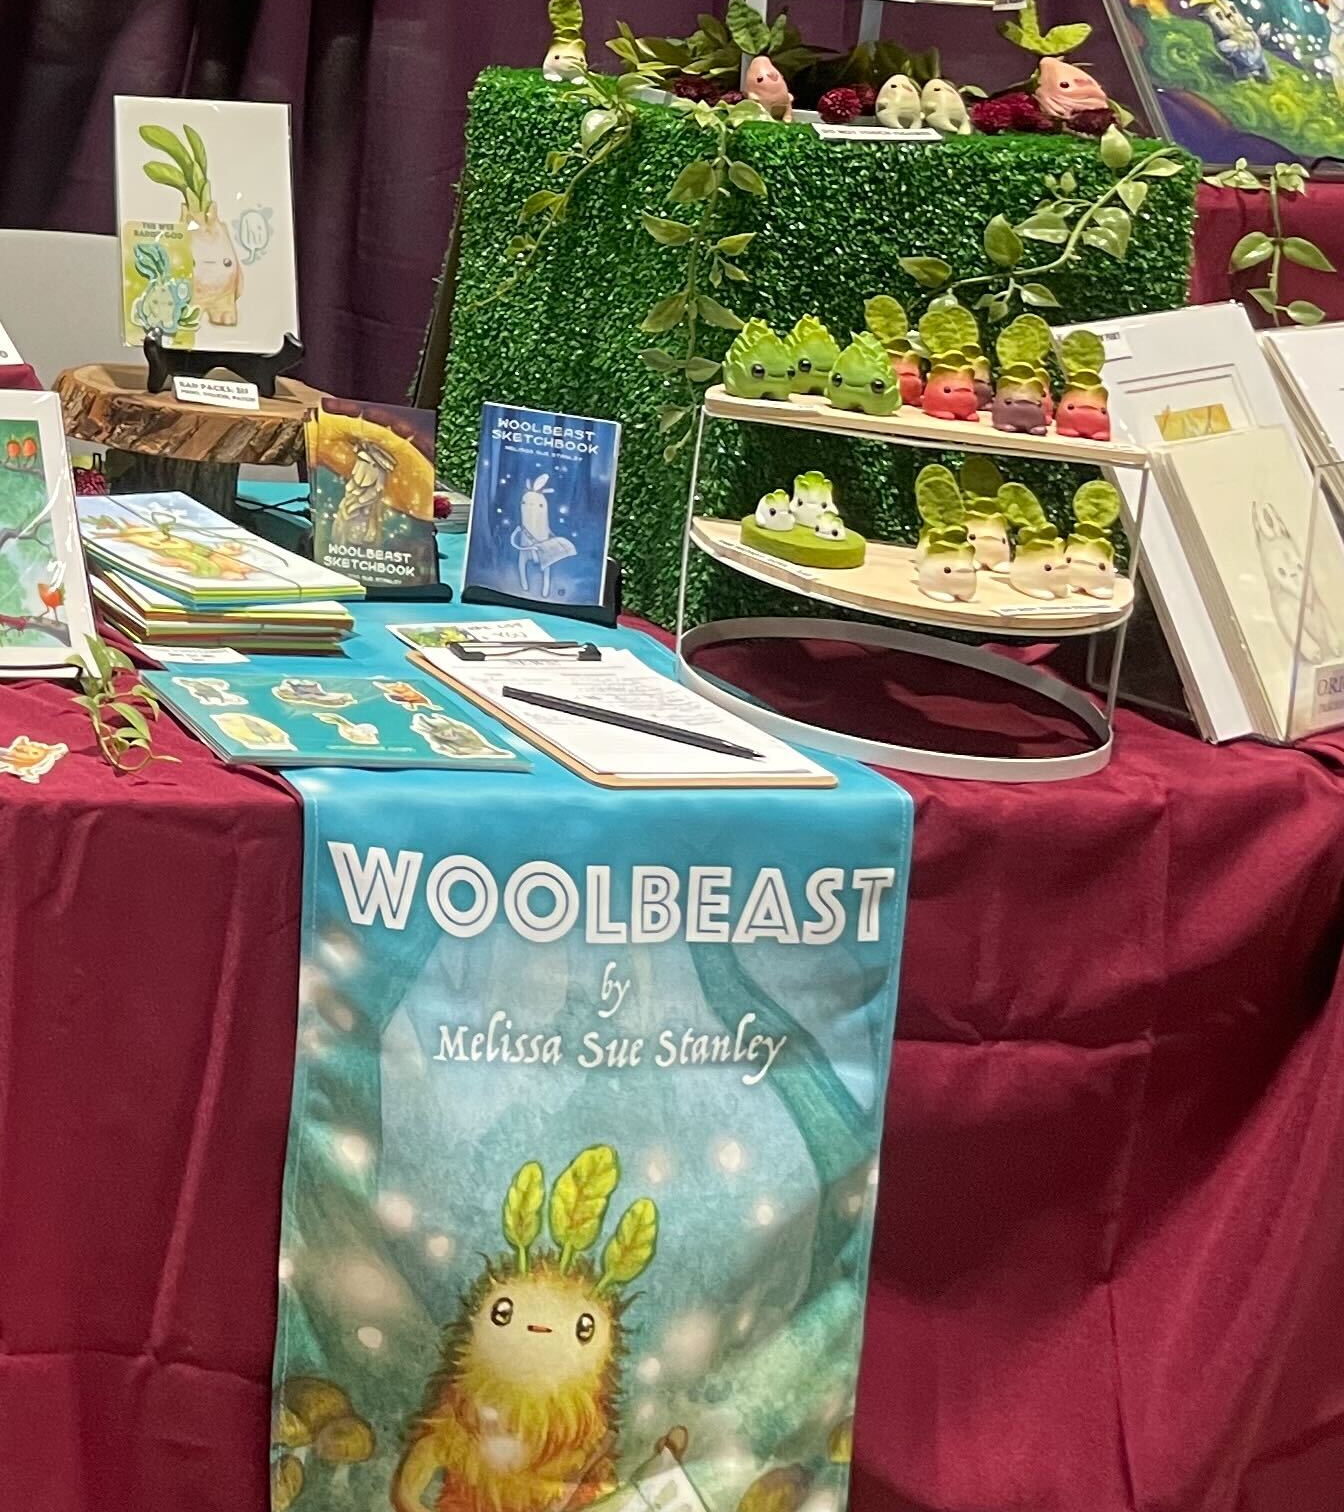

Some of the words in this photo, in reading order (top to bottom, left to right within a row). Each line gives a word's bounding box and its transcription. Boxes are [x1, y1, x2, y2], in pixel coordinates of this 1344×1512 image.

[492, 429, 600, 456] SKETCHBOOK
[498, 417, 596, 441] WOOLBEAST
[323, 555, 416, 577] SKETCHBOOK
[328, 543, 412, 563] WOOLBEAST
[326, 839, 896, 946] WOOLBEAST
[600, 960, 632, 1018] by
[433, 1010, 562, 1067] Melissa
[577, 1031, 642, 1069] Sue
[654, 1012, 789, 1086] Stanley
